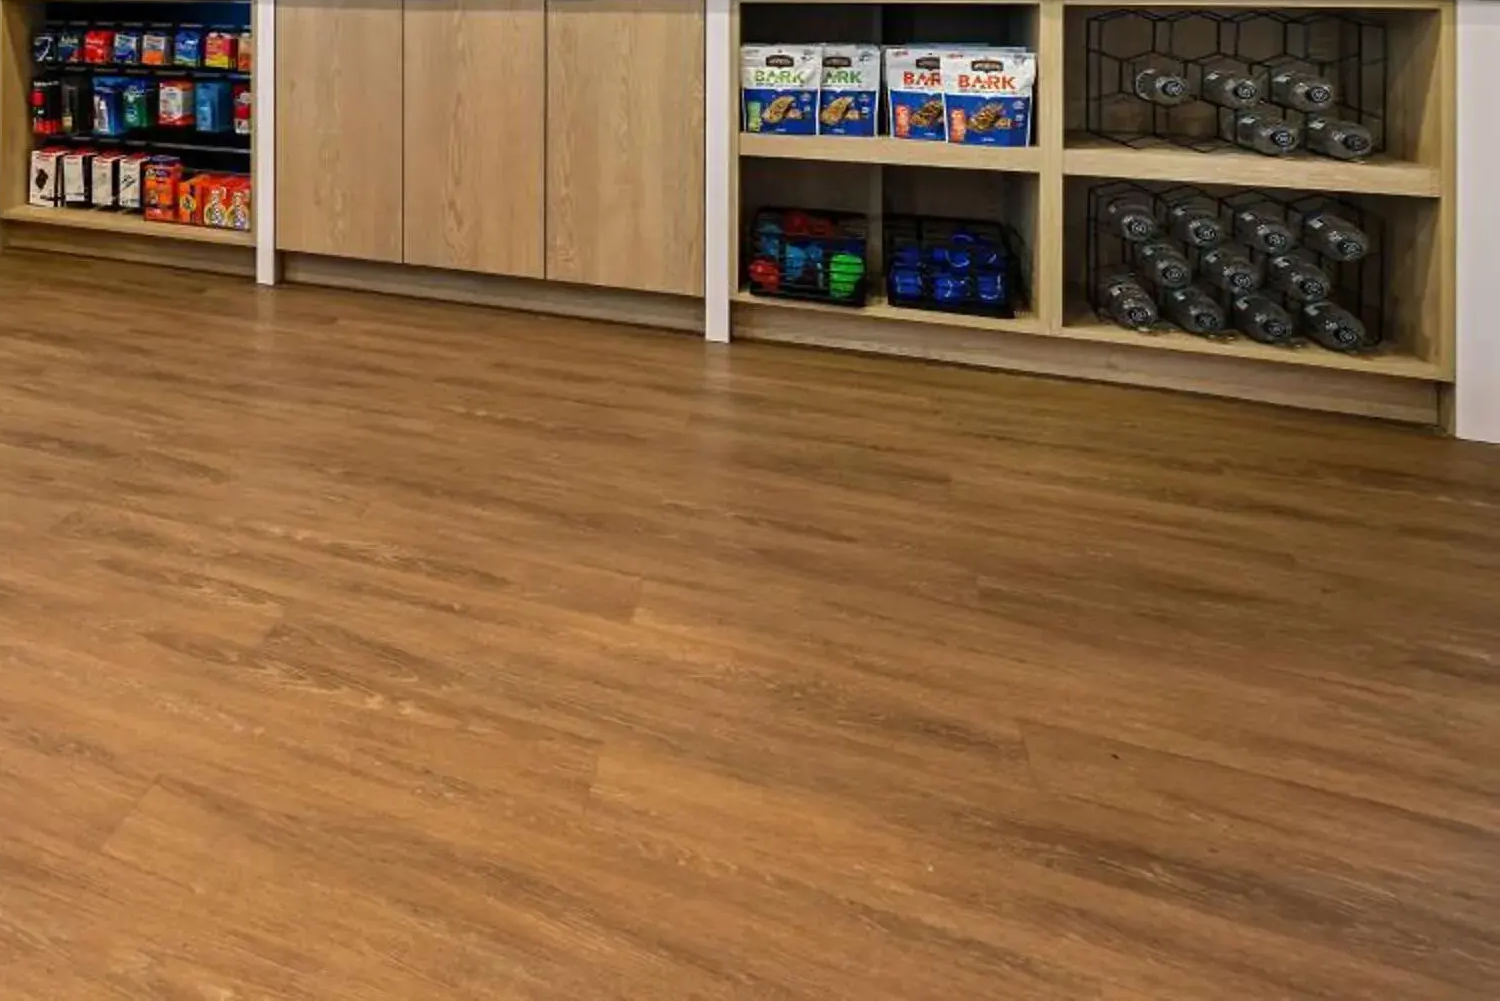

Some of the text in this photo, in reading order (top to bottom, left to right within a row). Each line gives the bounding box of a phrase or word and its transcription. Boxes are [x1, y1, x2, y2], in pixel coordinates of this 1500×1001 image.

[755, 69, 806, 84] BARK
[823, 69, 863, 85] ARK
[903, 70, 943, 87] BAR
[957, 73, 1017, 91] BARK
